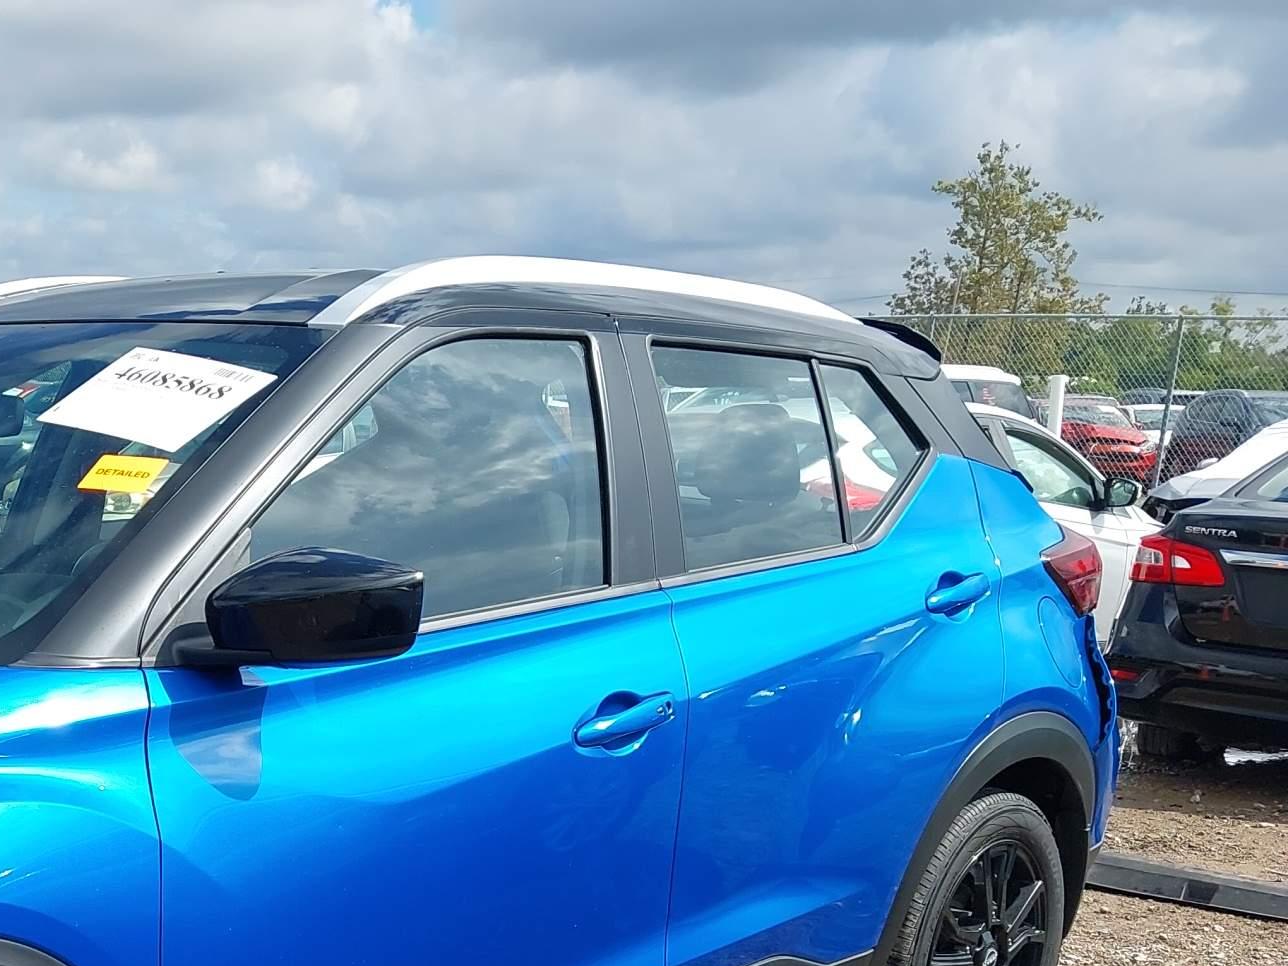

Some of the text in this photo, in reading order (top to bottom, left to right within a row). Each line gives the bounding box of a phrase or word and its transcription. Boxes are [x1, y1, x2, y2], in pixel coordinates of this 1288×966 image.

[115, 366, 232, 399] 46085868
[95, 468, 151, 479] DETAILED
[1184, 525, 1238, 538] SENTRA
